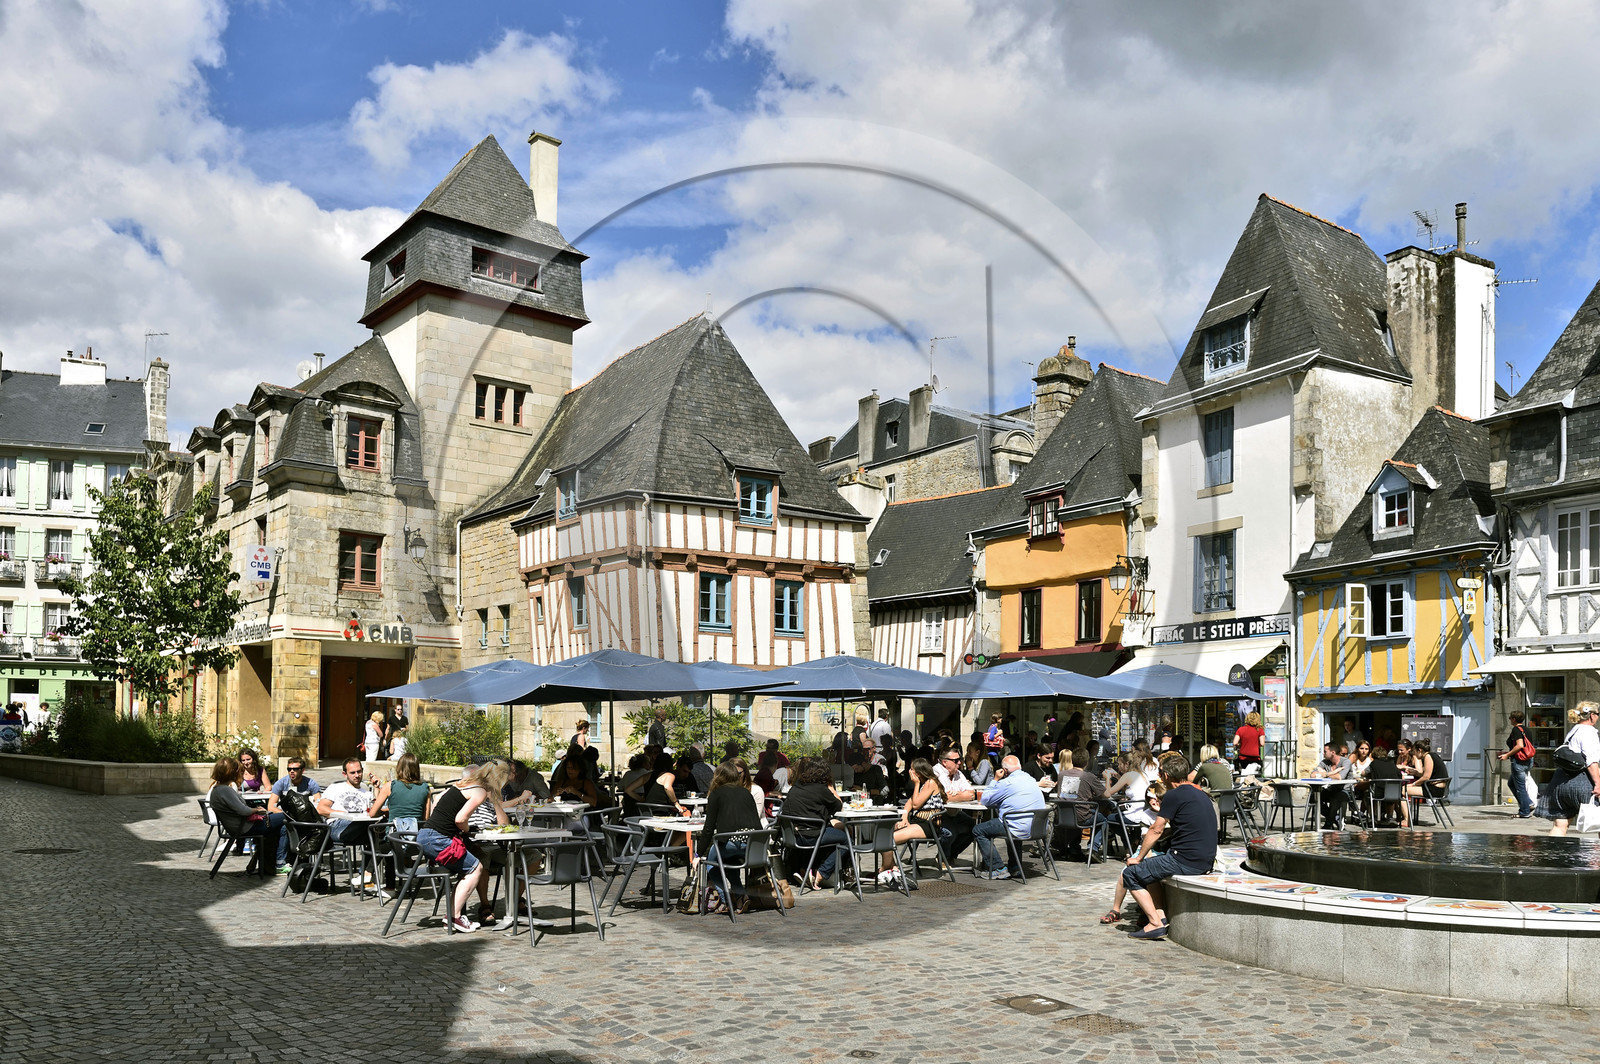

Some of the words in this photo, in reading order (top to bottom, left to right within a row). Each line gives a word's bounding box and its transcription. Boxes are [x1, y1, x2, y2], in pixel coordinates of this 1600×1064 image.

[250, 560, 271, 570] CMB
[243, 622, 271, 642] Bretagne
[368, 623, 413, 643] CMB
[1155, 628, 1184, 643] TABAC
[1193, 626, 1206, 640] LE
[1210, 622, 1245, 639] STEIR
[1249, 618, 1289, 634] PRESSE
[39, 668, 57, 676] DE
